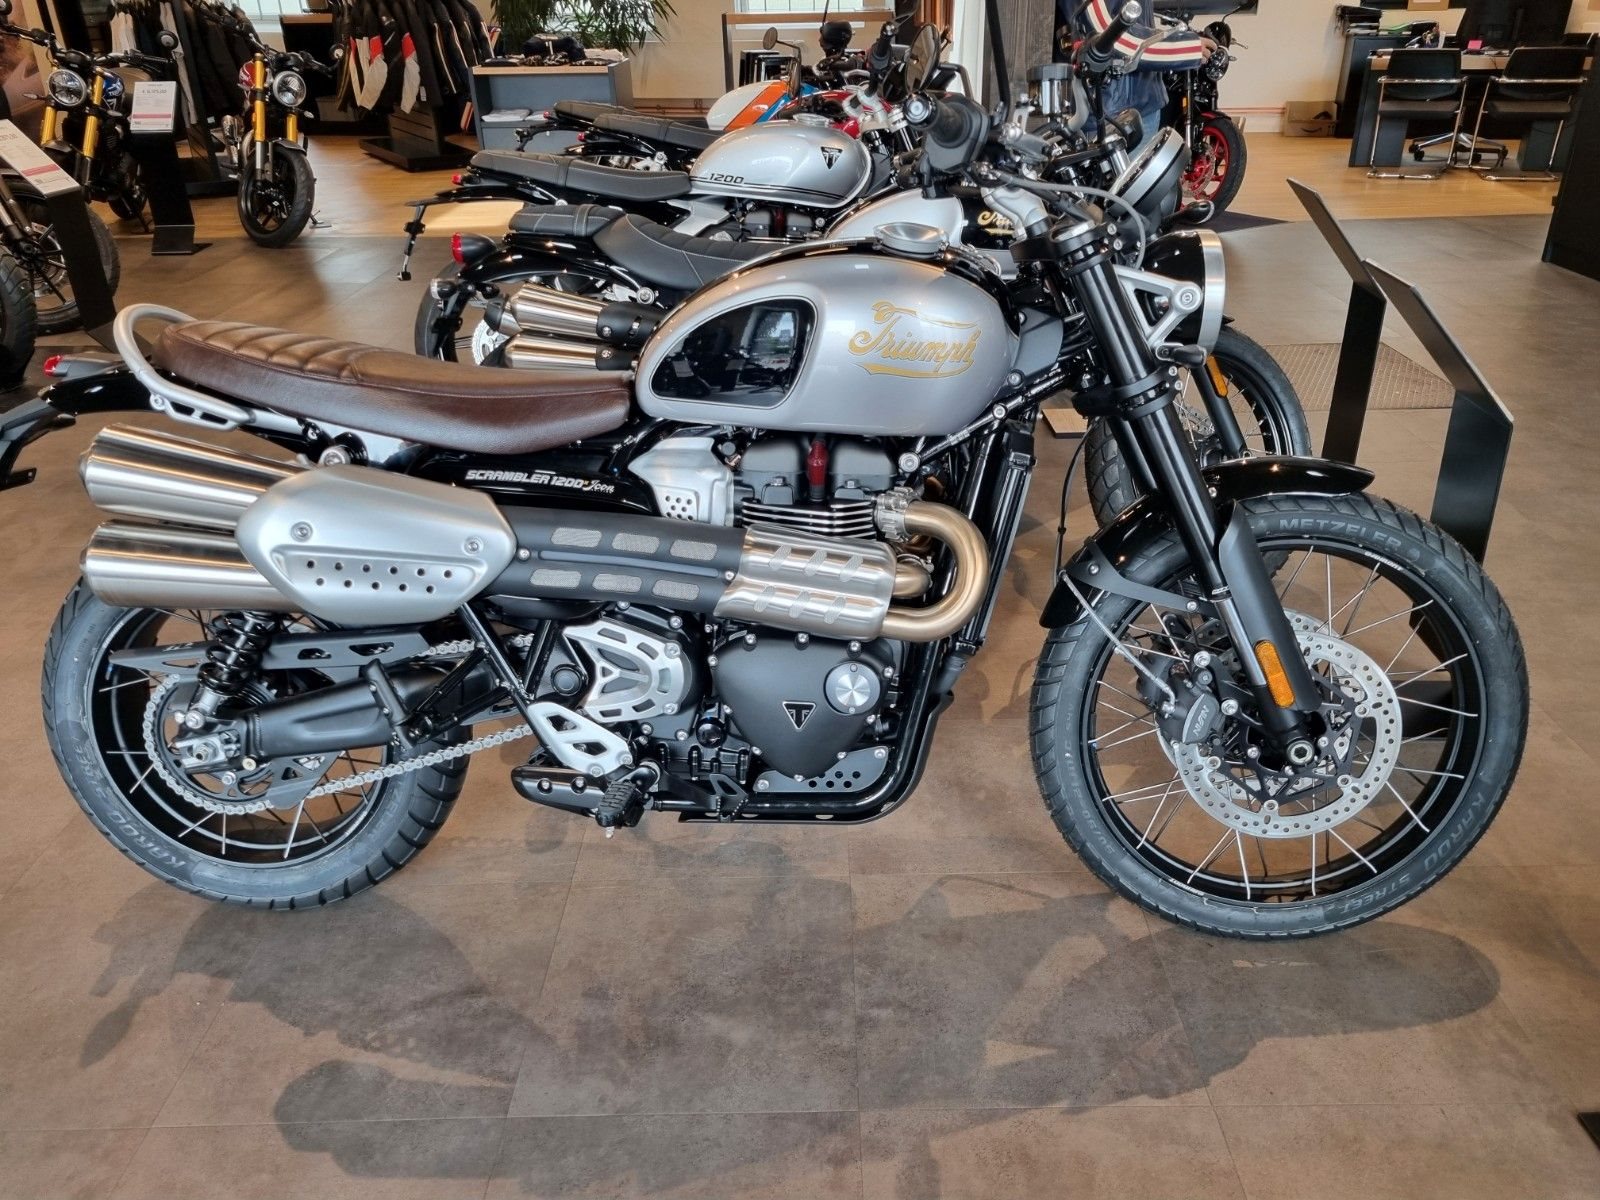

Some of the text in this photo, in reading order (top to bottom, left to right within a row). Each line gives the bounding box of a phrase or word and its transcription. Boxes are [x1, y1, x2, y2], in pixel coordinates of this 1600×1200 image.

[709, 173, 744, 184] 1200
[848, 300, 981, 379] Triumph
[465, 469, 550, 485] SCRAMBLER
[1279, 518, 1402, 551] METZELER
[1193, 704, 1210, 737] NISSIN
[109, 810, 186, 868] KAROO
[1340, 792, 1486, 914] KAROO STREET
